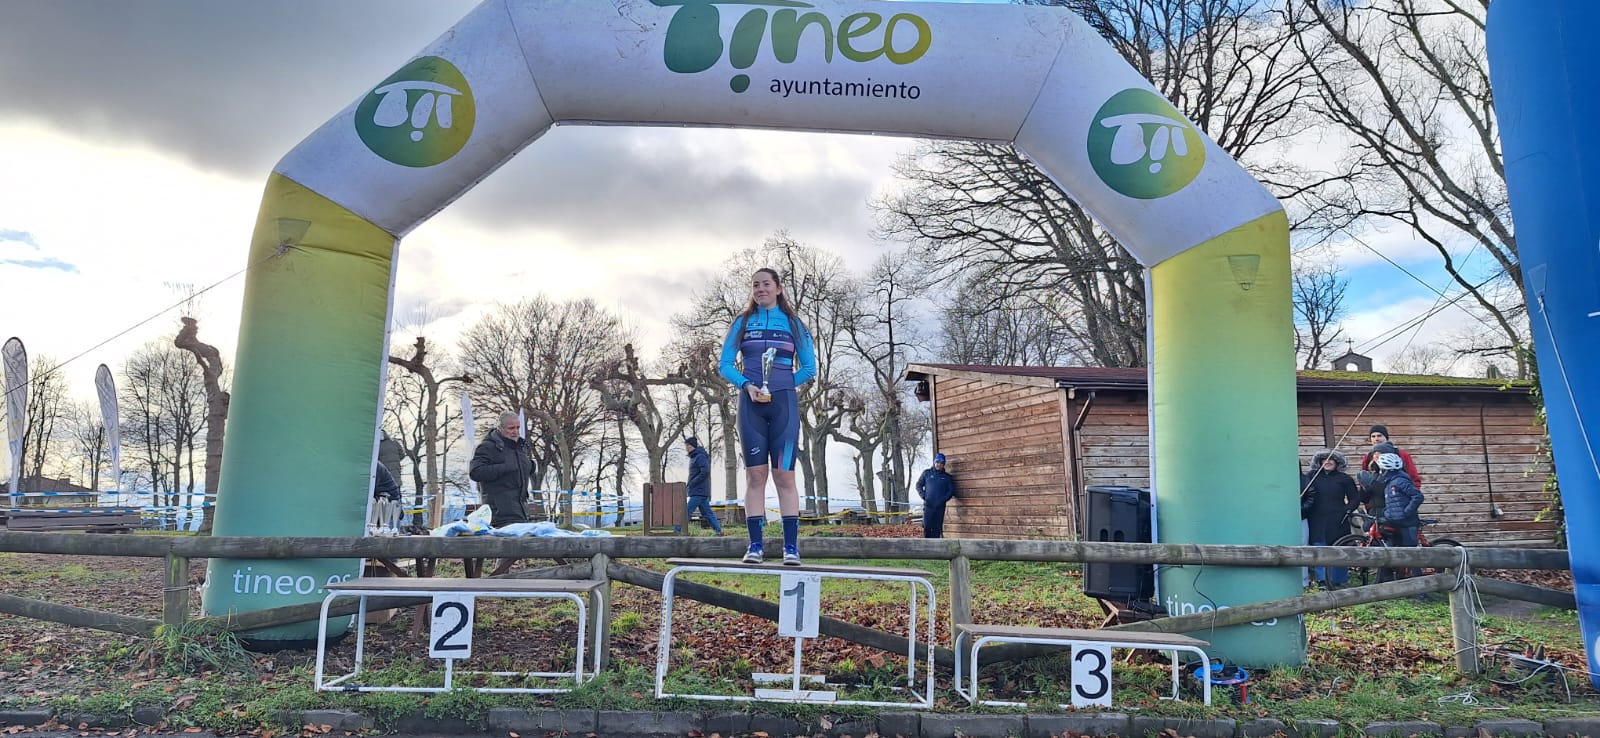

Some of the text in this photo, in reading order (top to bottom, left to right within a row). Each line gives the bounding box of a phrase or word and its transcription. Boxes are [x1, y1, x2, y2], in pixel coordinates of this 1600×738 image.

[769, 78, 921, 100] ayuntamiento
[433, 601, 469, 651] 2
[783, 581, 805, 632] 1
[1074, 648, 1109, 699] 3
